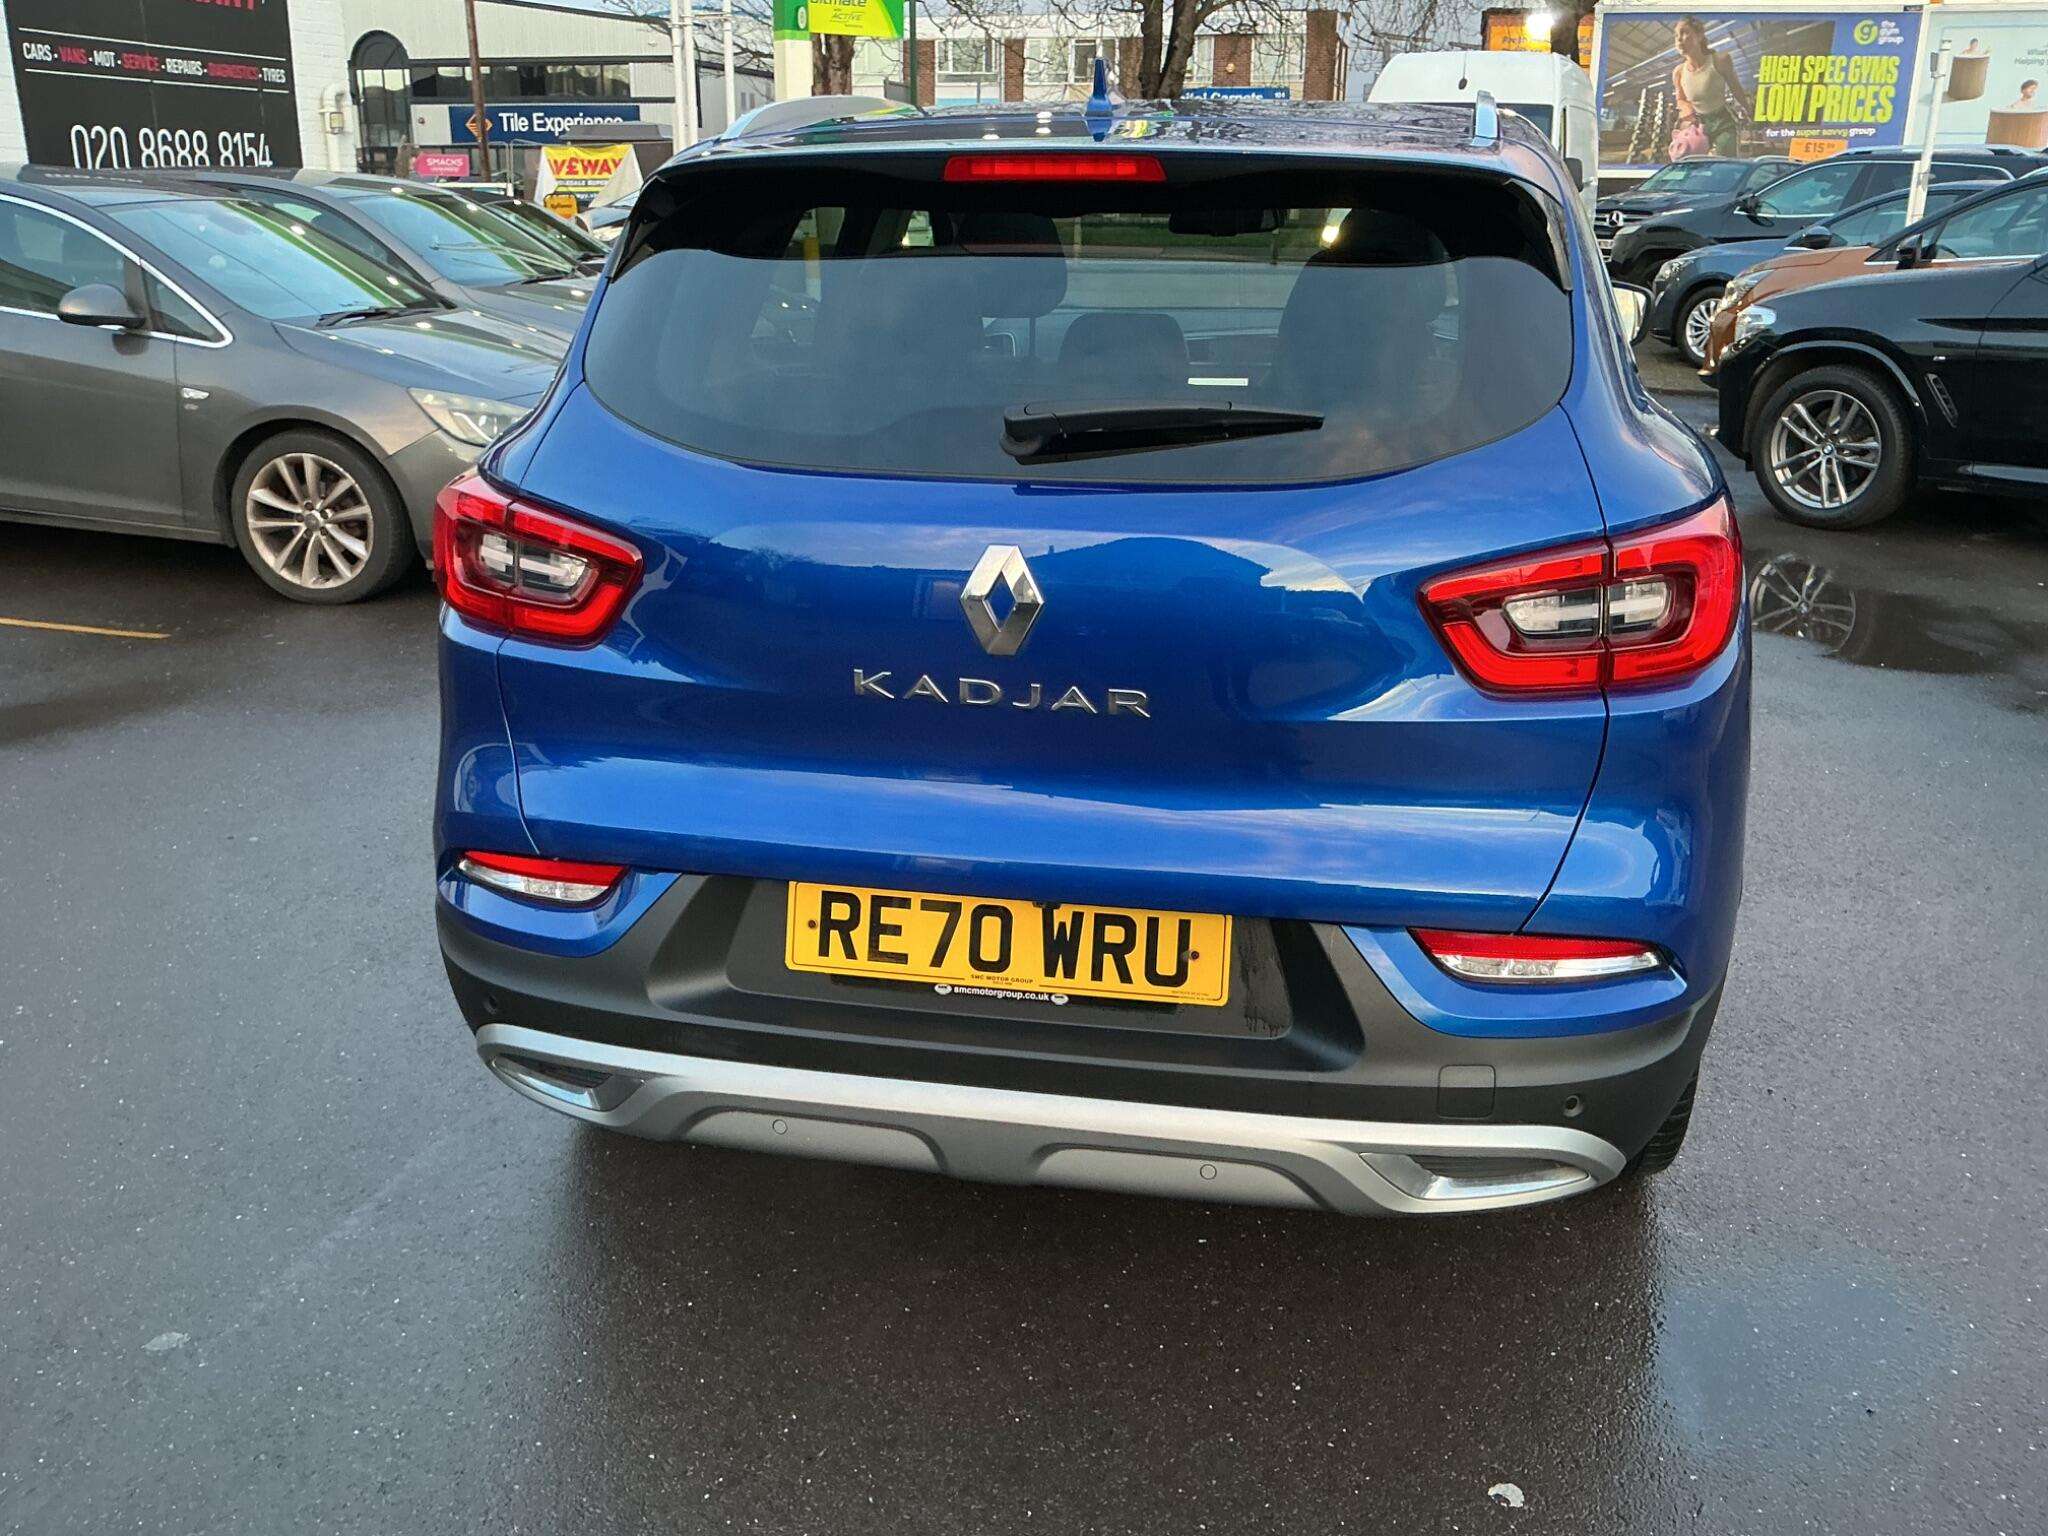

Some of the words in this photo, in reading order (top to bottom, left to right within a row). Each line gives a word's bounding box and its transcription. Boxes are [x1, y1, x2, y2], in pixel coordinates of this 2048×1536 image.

[22, 42, 53, 61] CARS
[59, 46, 88, 65] VANS
[93, 50, 116, 68] MOT
[121, 53, 161, 72] SERVICE
[165, 58, 203, 76] REPAIRS
[262, 67, 287, 84] TYRES
[1758, 55, 1802, 84] HIGH
[1802, 55, 1849, 84] SPEC
[1848, 55, 1901, 84] GYMS
[498, 112, 529, 132] Tile
[1753, 83, 1808, 122] LOW
[1807, 84, 1896, 123] PRICES
[70, 125, 132, 170] 020
[138, 127, 211, 168] 8688
[218, 131, 273, 168] 8154
[1766, 128, 1779, 137] for
[1781, 128, 1796, 137] the
[1796, 129, 1821, 138] super
[1849, 127, 1876, 136] group
[854, 669, 1151, 718] KADJAR
[818, 890, 1014, 973] RE70
[1041, 904, 1192, 988] WRU
[954, 986, 1050, 1002] smcmotorgroup.co.uk
